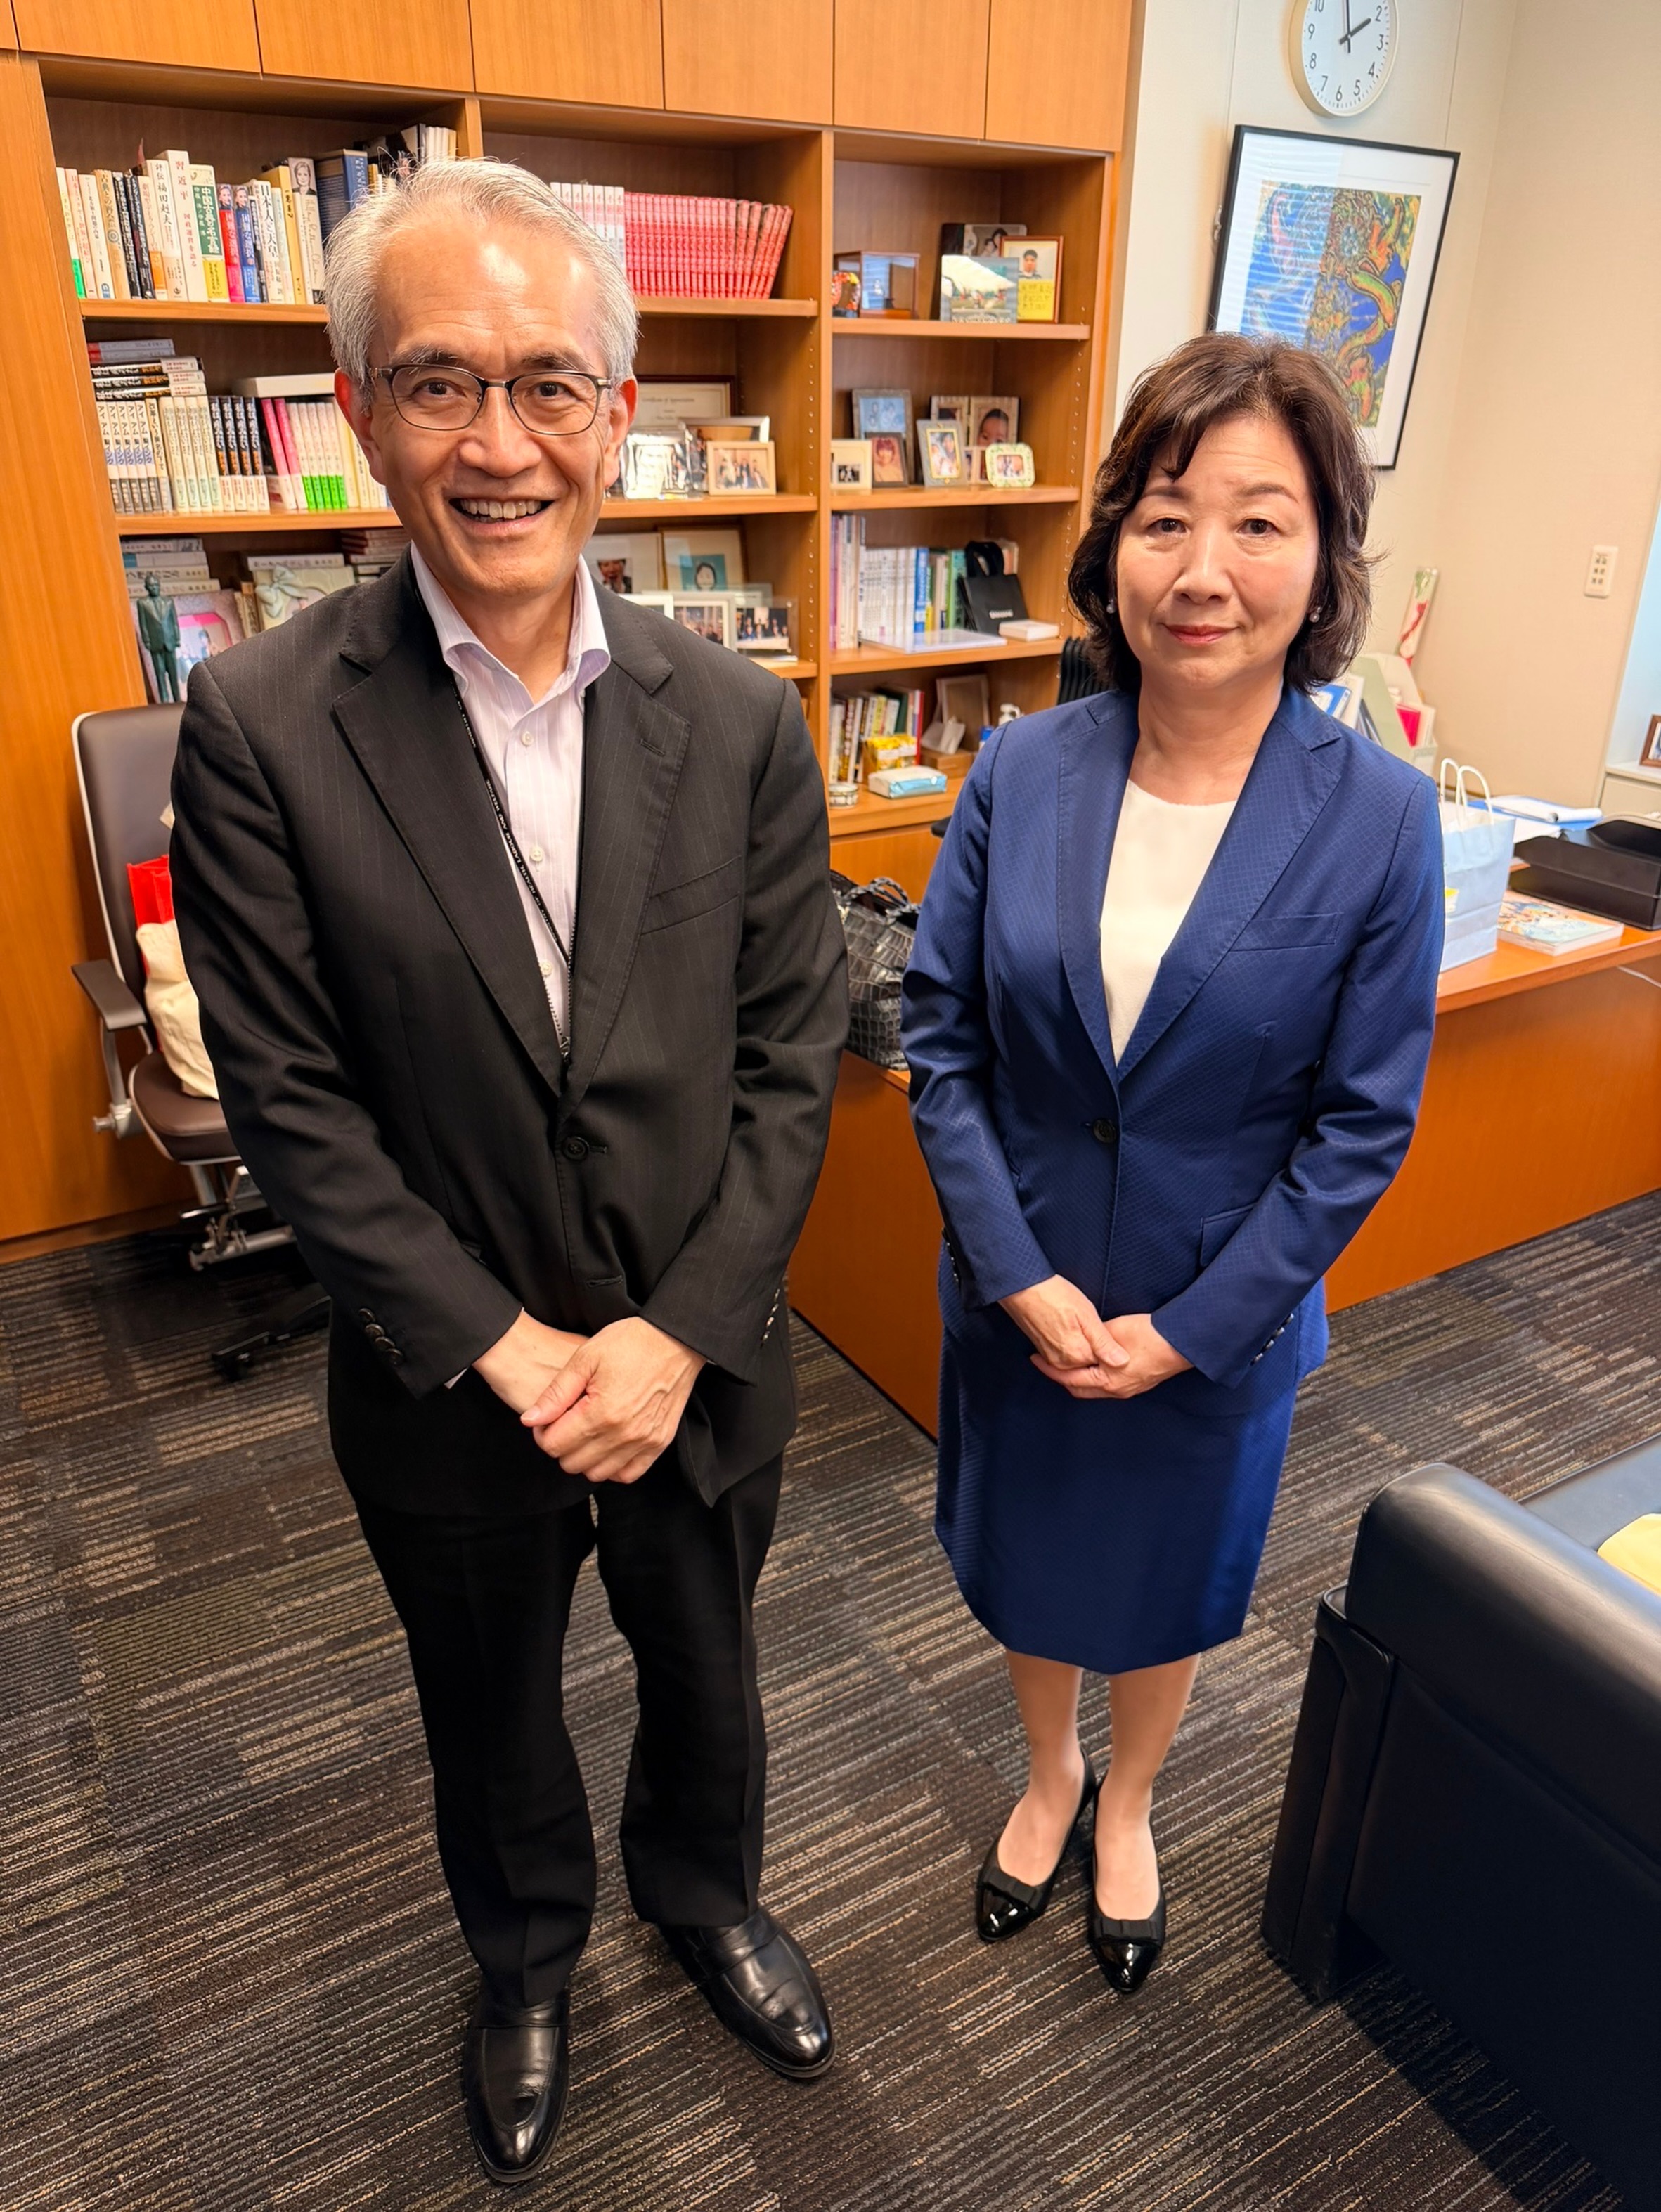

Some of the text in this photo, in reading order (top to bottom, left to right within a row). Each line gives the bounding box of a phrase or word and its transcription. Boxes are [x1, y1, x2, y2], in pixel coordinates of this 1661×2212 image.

[1375, 5, 1382, 22] 2
[1308, 24, 1315, 40] 9
[1376, 34, 1384, 51] 3
[1310, 53, 1317, 69] 8
[1368, 62, 1375, 78] 4
[1321, 75, 1328, 92] 7
[1353, 79, 1361, 96] 5
[1336, 85, 1343, 101] 6
[486, 779, 500, 812] WELFARE
[498, 814, 508, 830] AND
[505, 832, 522, 863] LABOUR
[535, 896, 541, 906] OF
